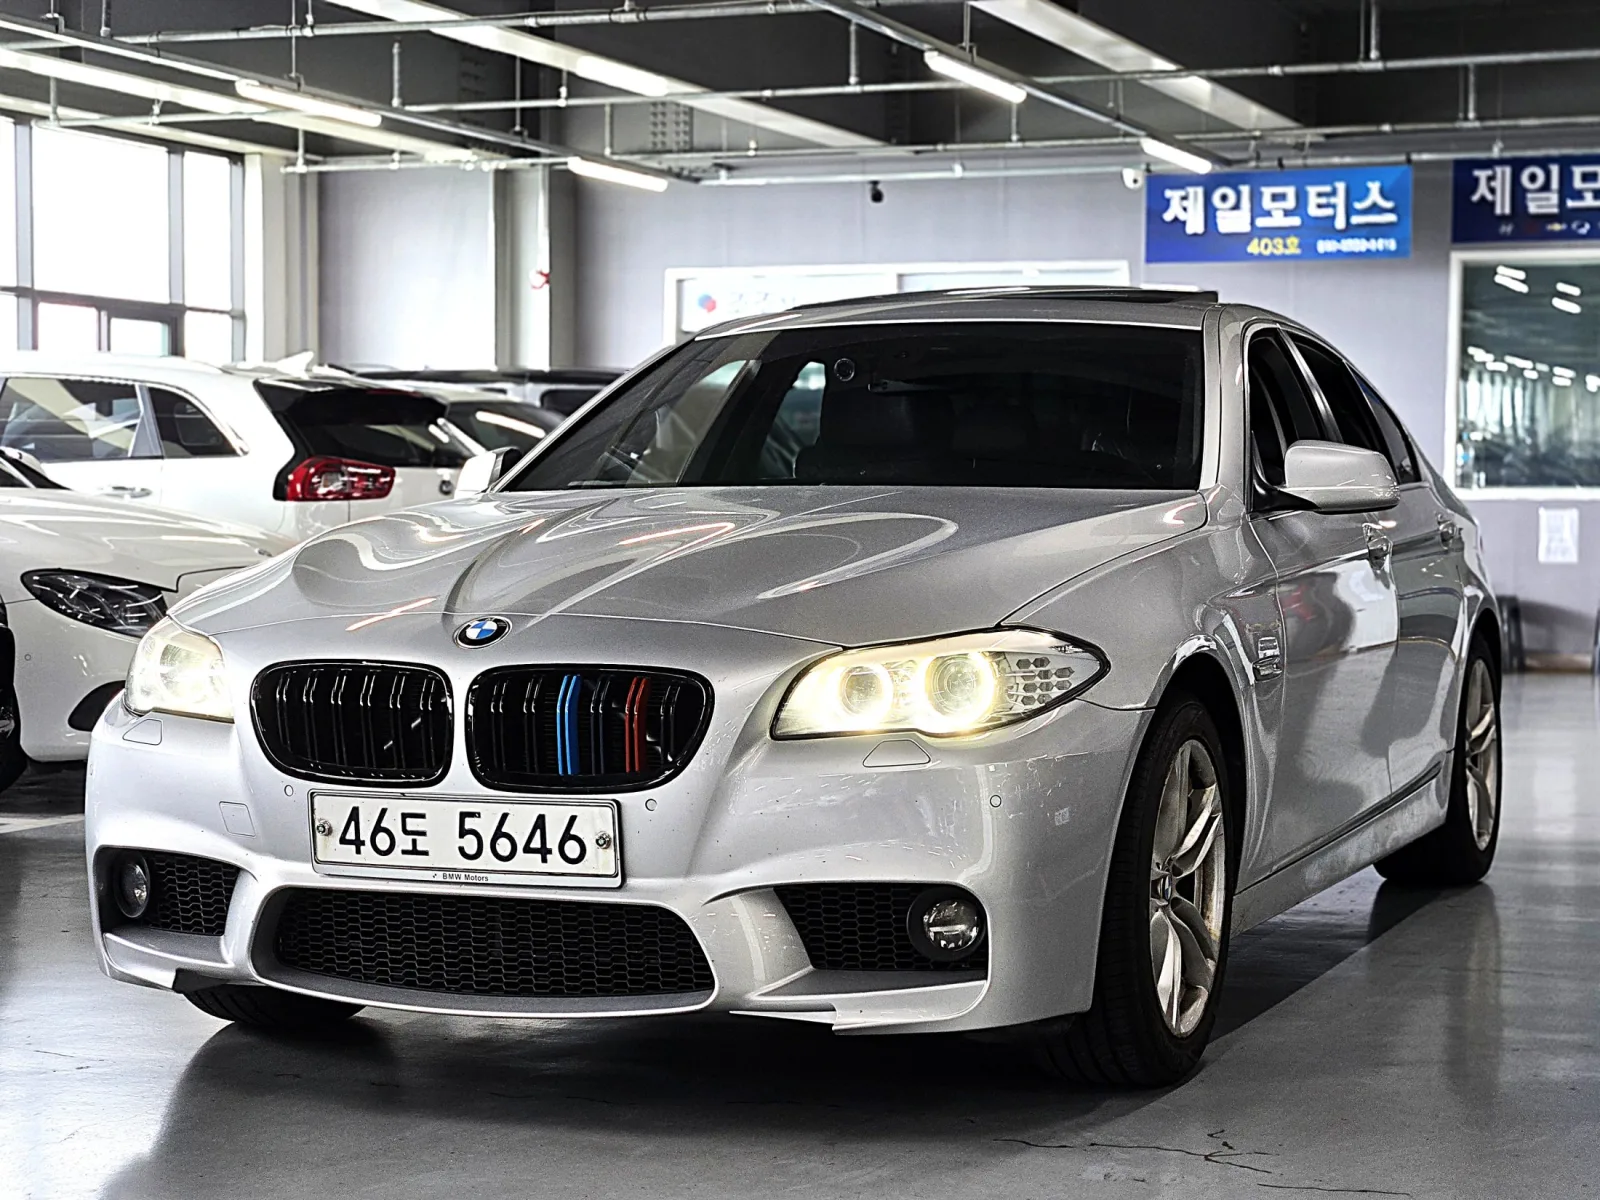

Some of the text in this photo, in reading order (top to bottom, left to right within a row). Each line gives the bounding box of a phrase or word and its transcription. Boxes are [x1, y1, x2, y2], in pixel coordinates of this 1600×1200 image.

[1162, 181, 1398, 234] 제일모터스
[1247, 236, 1301, 255] 403호
[339, 806, 588, 865] 46도 5646
[442, 872, 489, 882] BMW Motors
